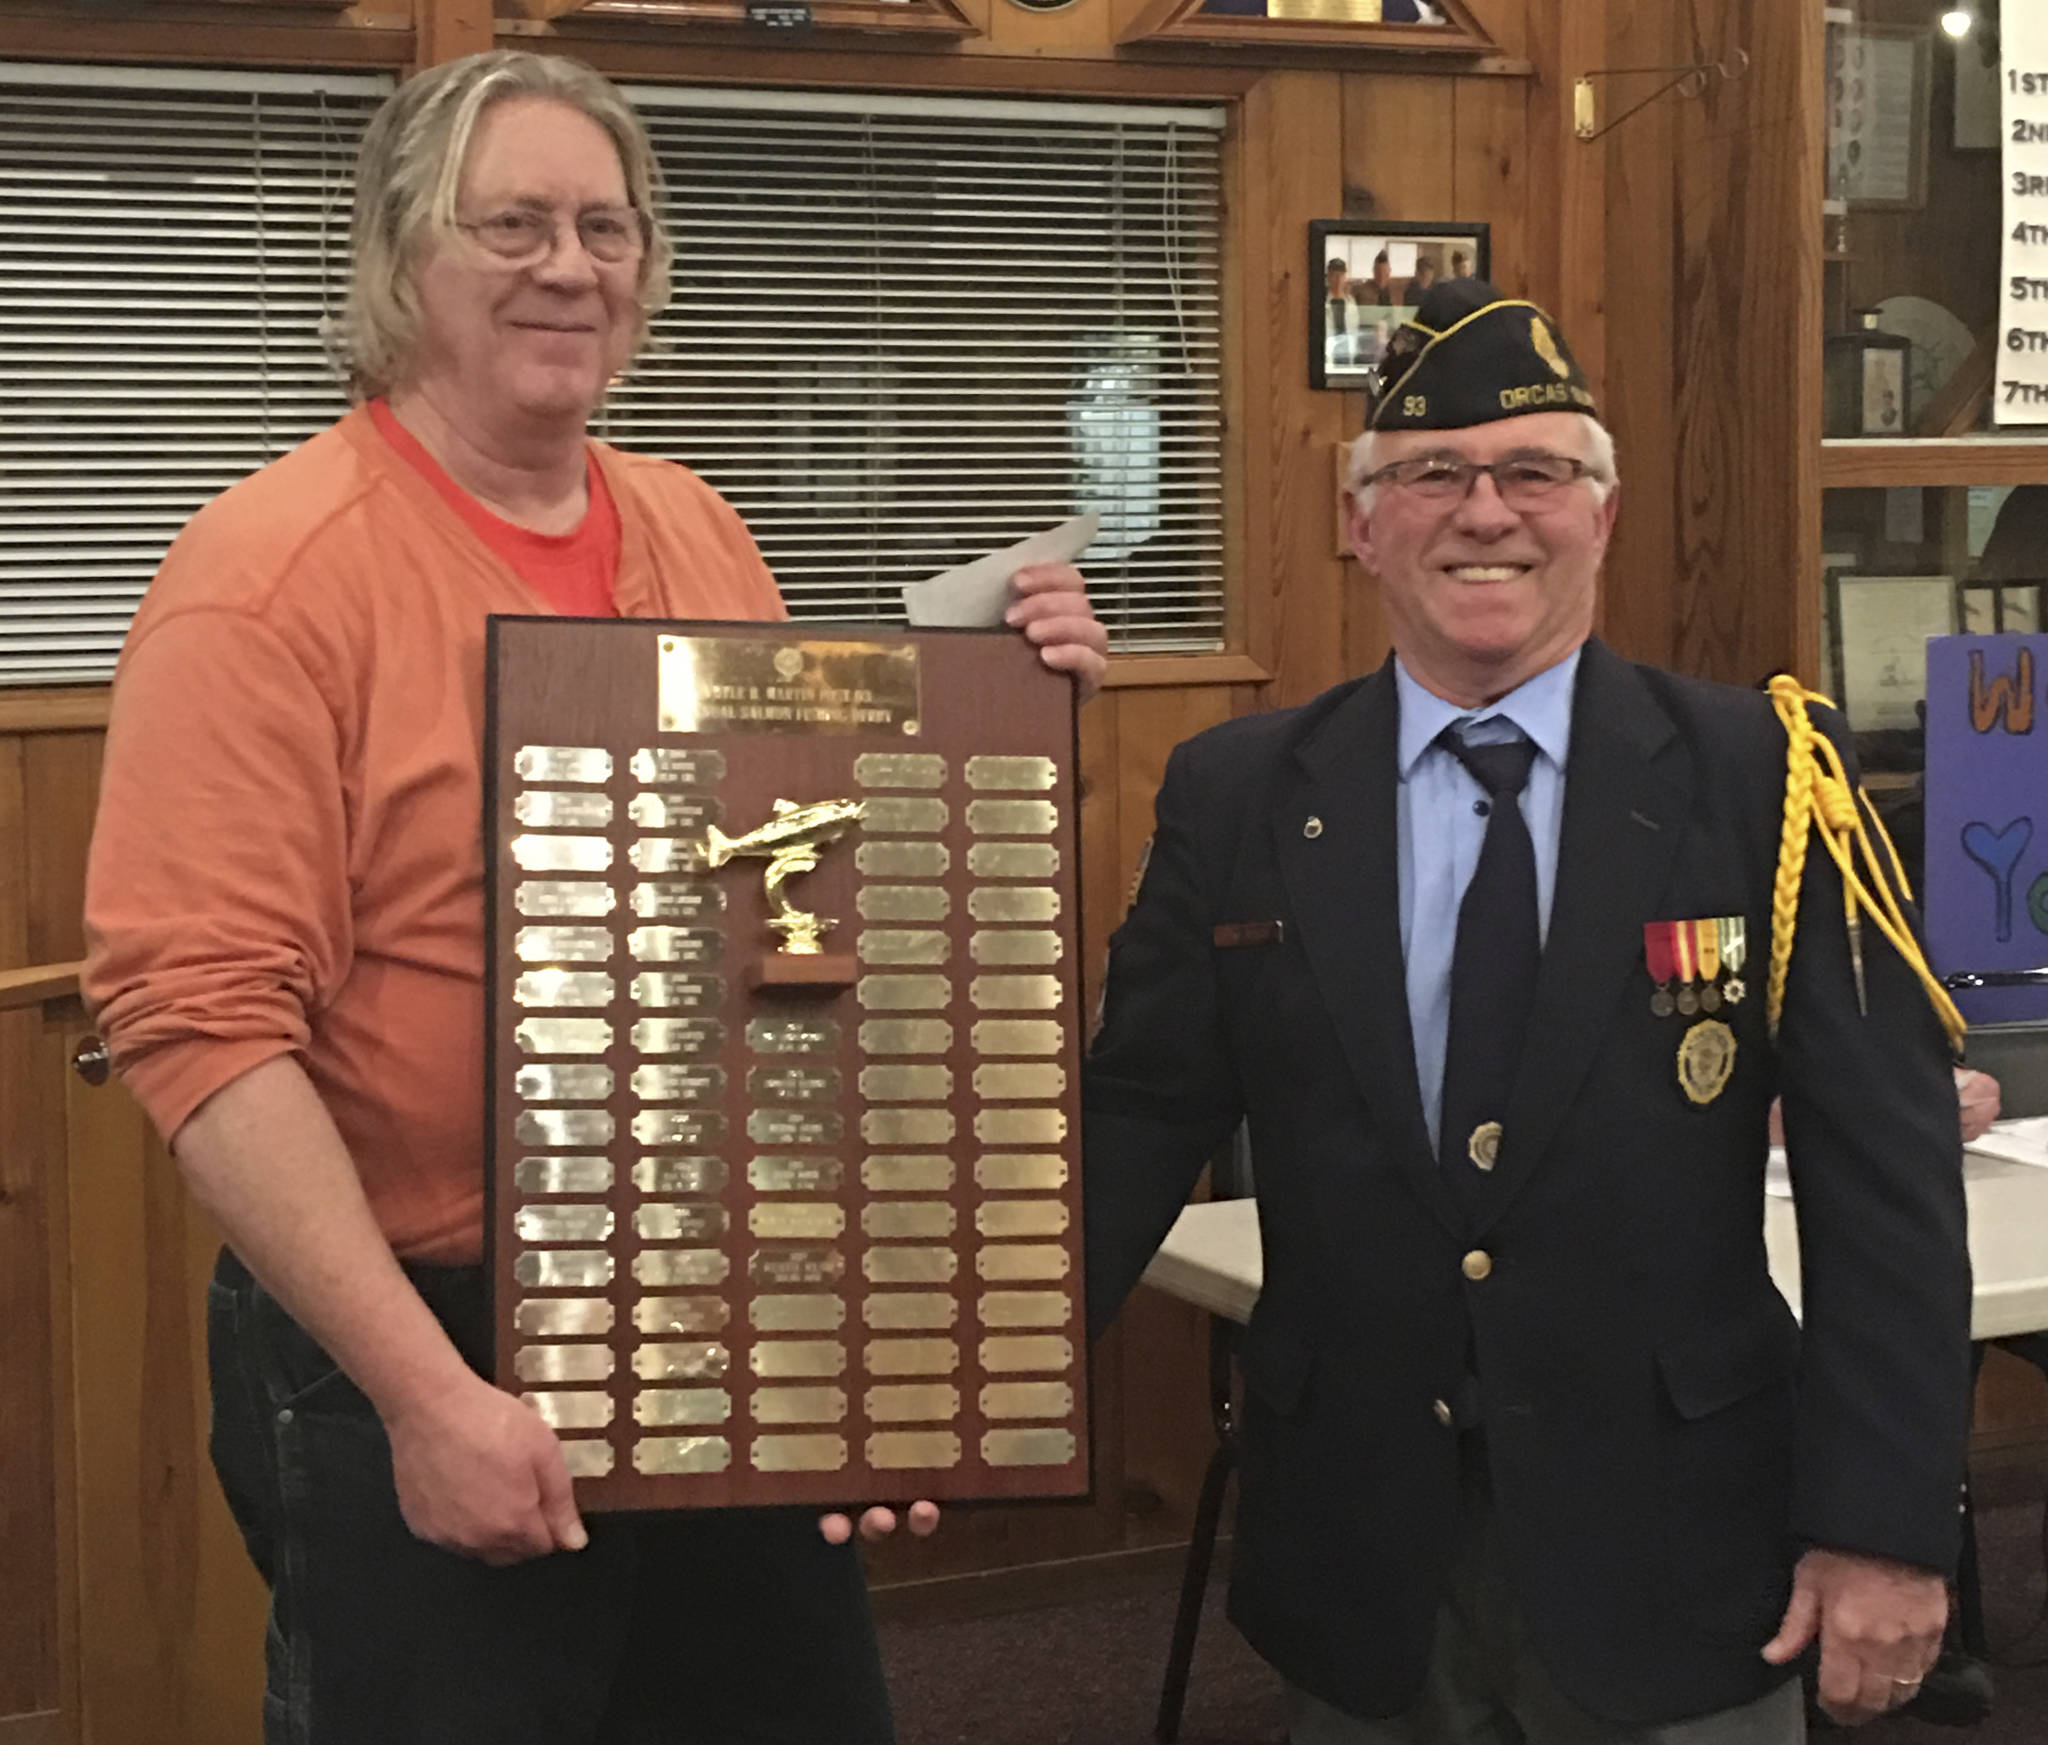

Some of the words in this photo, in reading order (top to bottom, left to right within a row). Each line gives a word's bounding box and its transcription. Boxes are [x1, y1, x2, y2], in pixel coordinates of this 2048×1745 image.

[2008, 69, 2048, 94] 1ST
[2012, 119, 2048, 143] 2N
[2012, 171, 2048, 197] 3R
[1500, 383, 1568, 410] ORCAS
[2002, 381, 2048, 404] 7TH
[1403, 395, 1426, 417] 93
[1968, 646, 2048, 735] W
